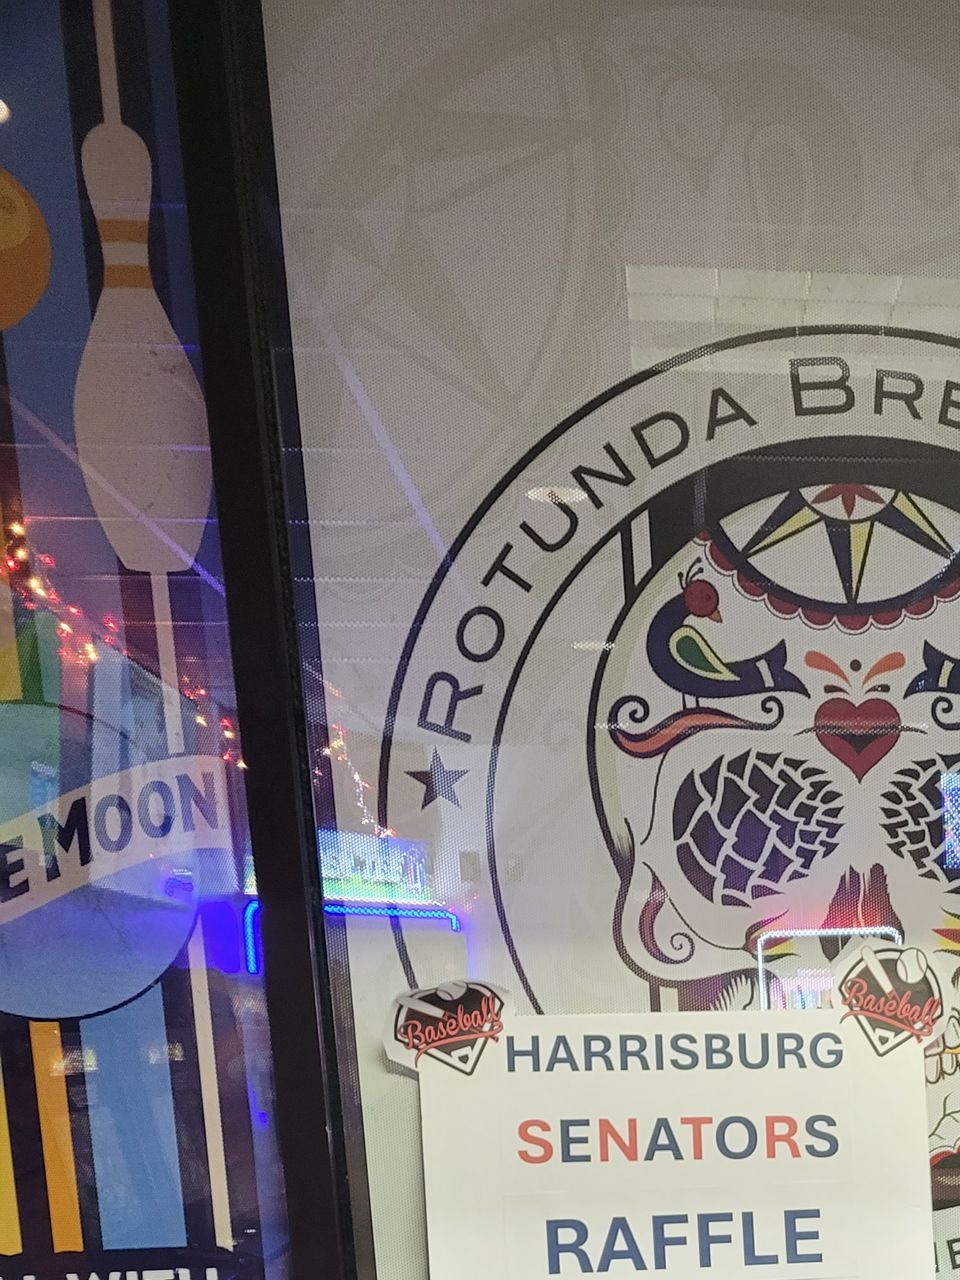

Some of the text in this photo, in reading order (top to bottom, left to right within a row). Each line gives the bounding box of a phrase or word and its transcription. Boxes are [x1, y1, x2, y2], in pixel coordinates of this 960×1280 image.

[417, 386, 758, 742] ROTUNDA
[38, 771, 220, 882] MOON
[403, 996, 502, 1051] Baseball
[841, 977, 941, 1030] Baseball
[506, 1032, 844, 1073] HARRISBURG
[517, 1115, 840, 1164] SENATORS
[545, 1208, 824, 1275] RAFFLE
